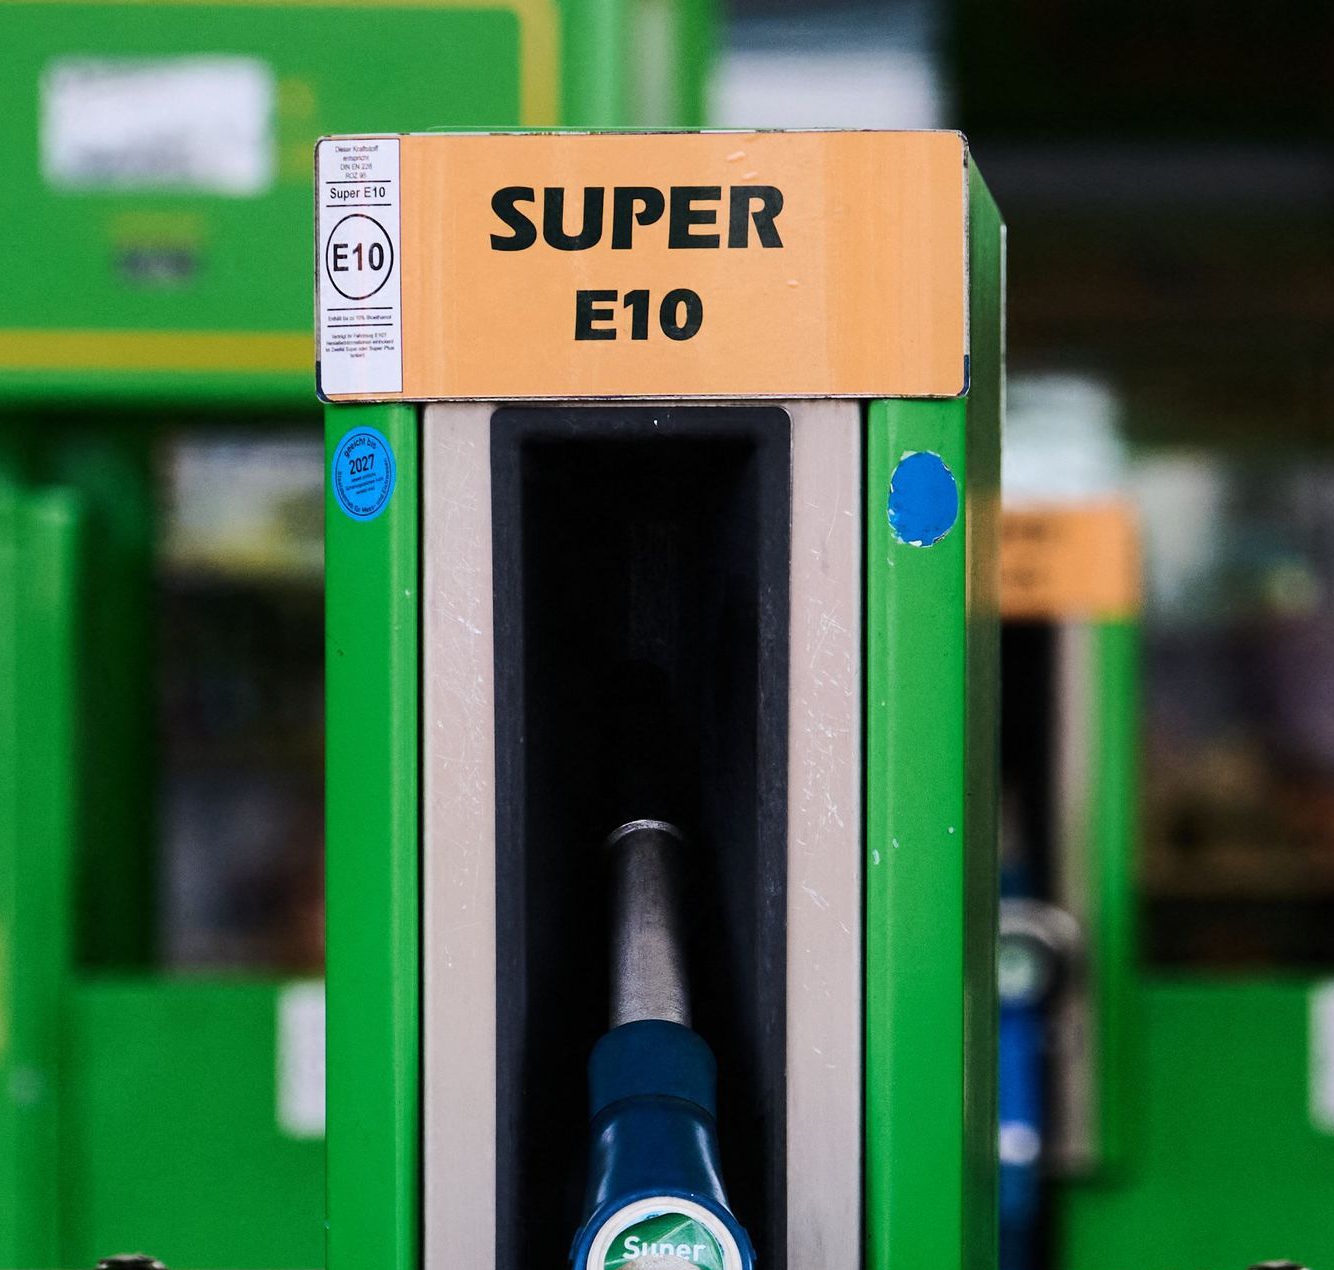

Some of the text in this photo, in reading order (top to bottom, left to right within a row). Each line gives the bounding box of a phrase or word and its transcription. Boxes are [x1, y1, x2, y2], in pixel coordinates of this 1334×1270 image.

[330, 186, 386, 200] Super E10
[489, 185, 784, 252] SUPER
[333, 242, 384, 272] E10
[575, 288, 703, 342] E10
[344, 437, 377, 458] geeicht bis
[349, 453, 374, 475] 2027
